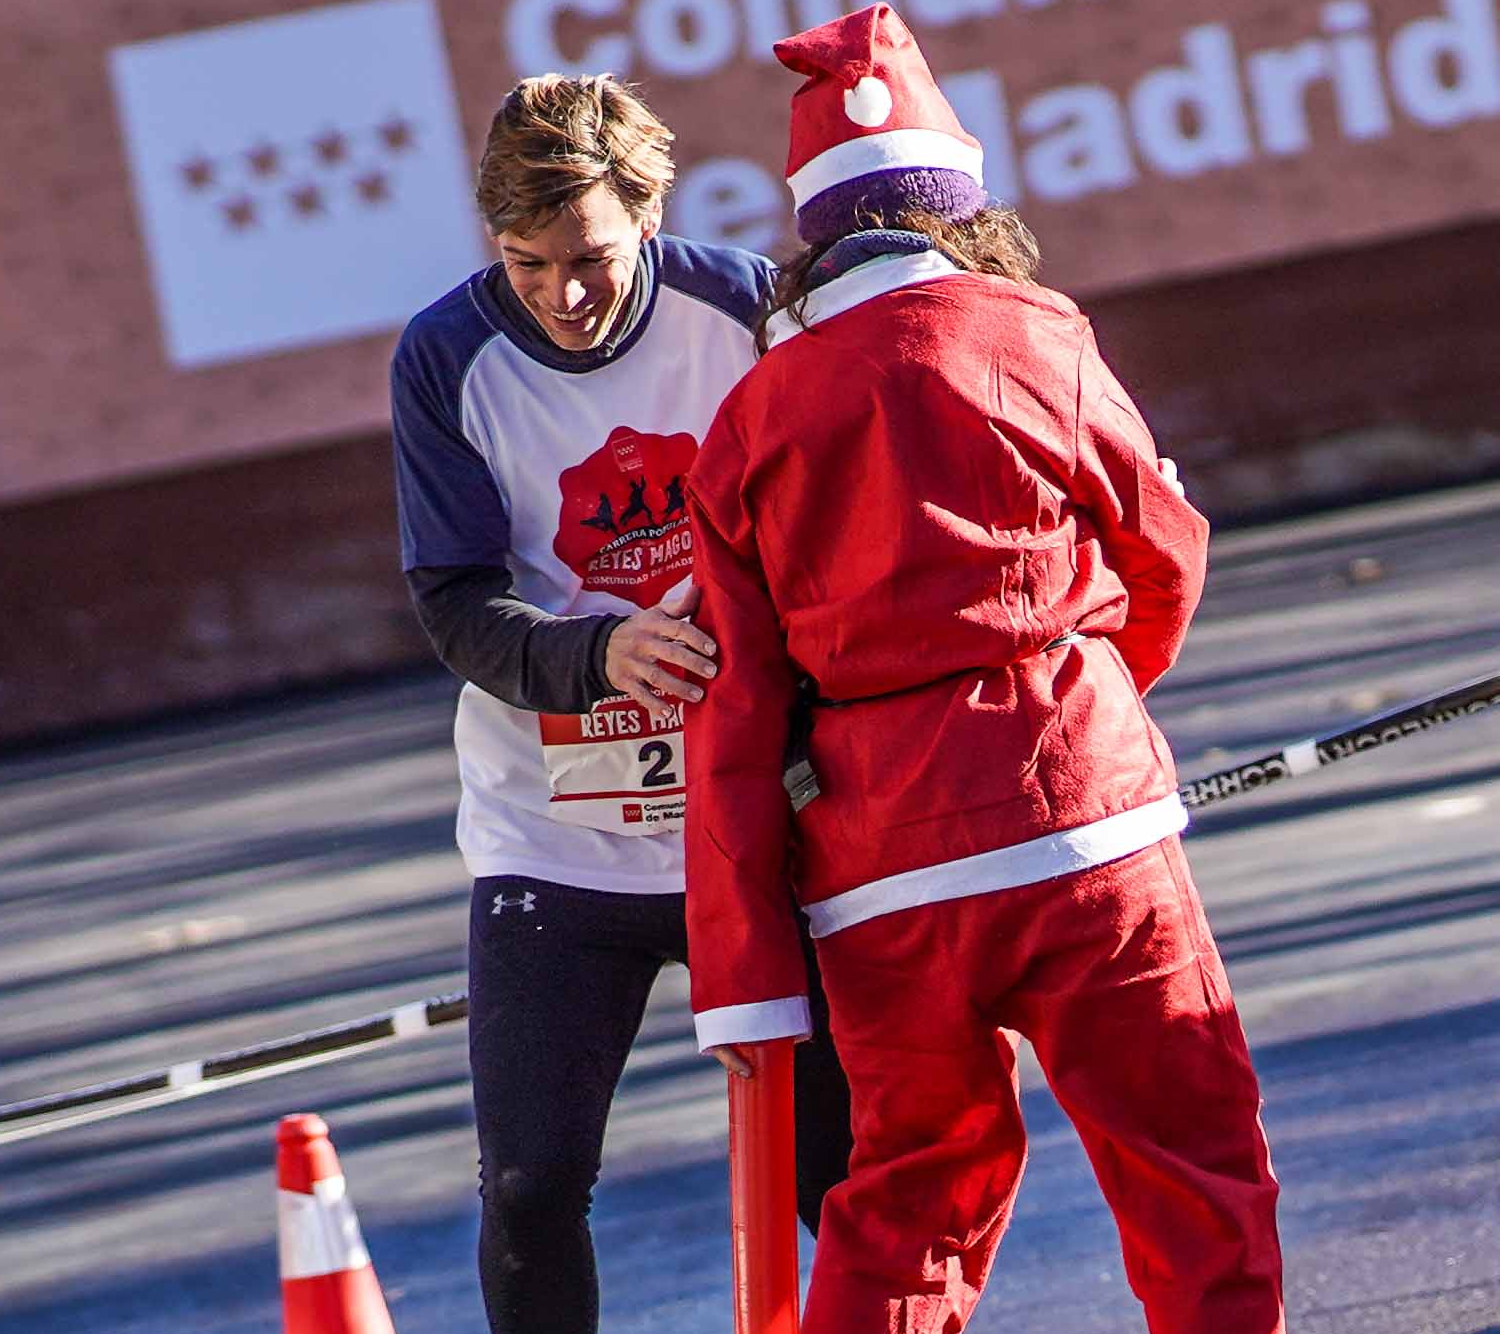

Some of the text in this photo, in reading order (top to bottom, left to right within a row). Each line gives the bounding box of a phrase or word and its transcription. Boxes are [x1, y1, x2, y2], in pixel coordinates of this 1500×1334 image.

[587, 546, 644, 572] REYES
[580, 709, 641, 738] REYES
[638, 740, 677, 788] 2
